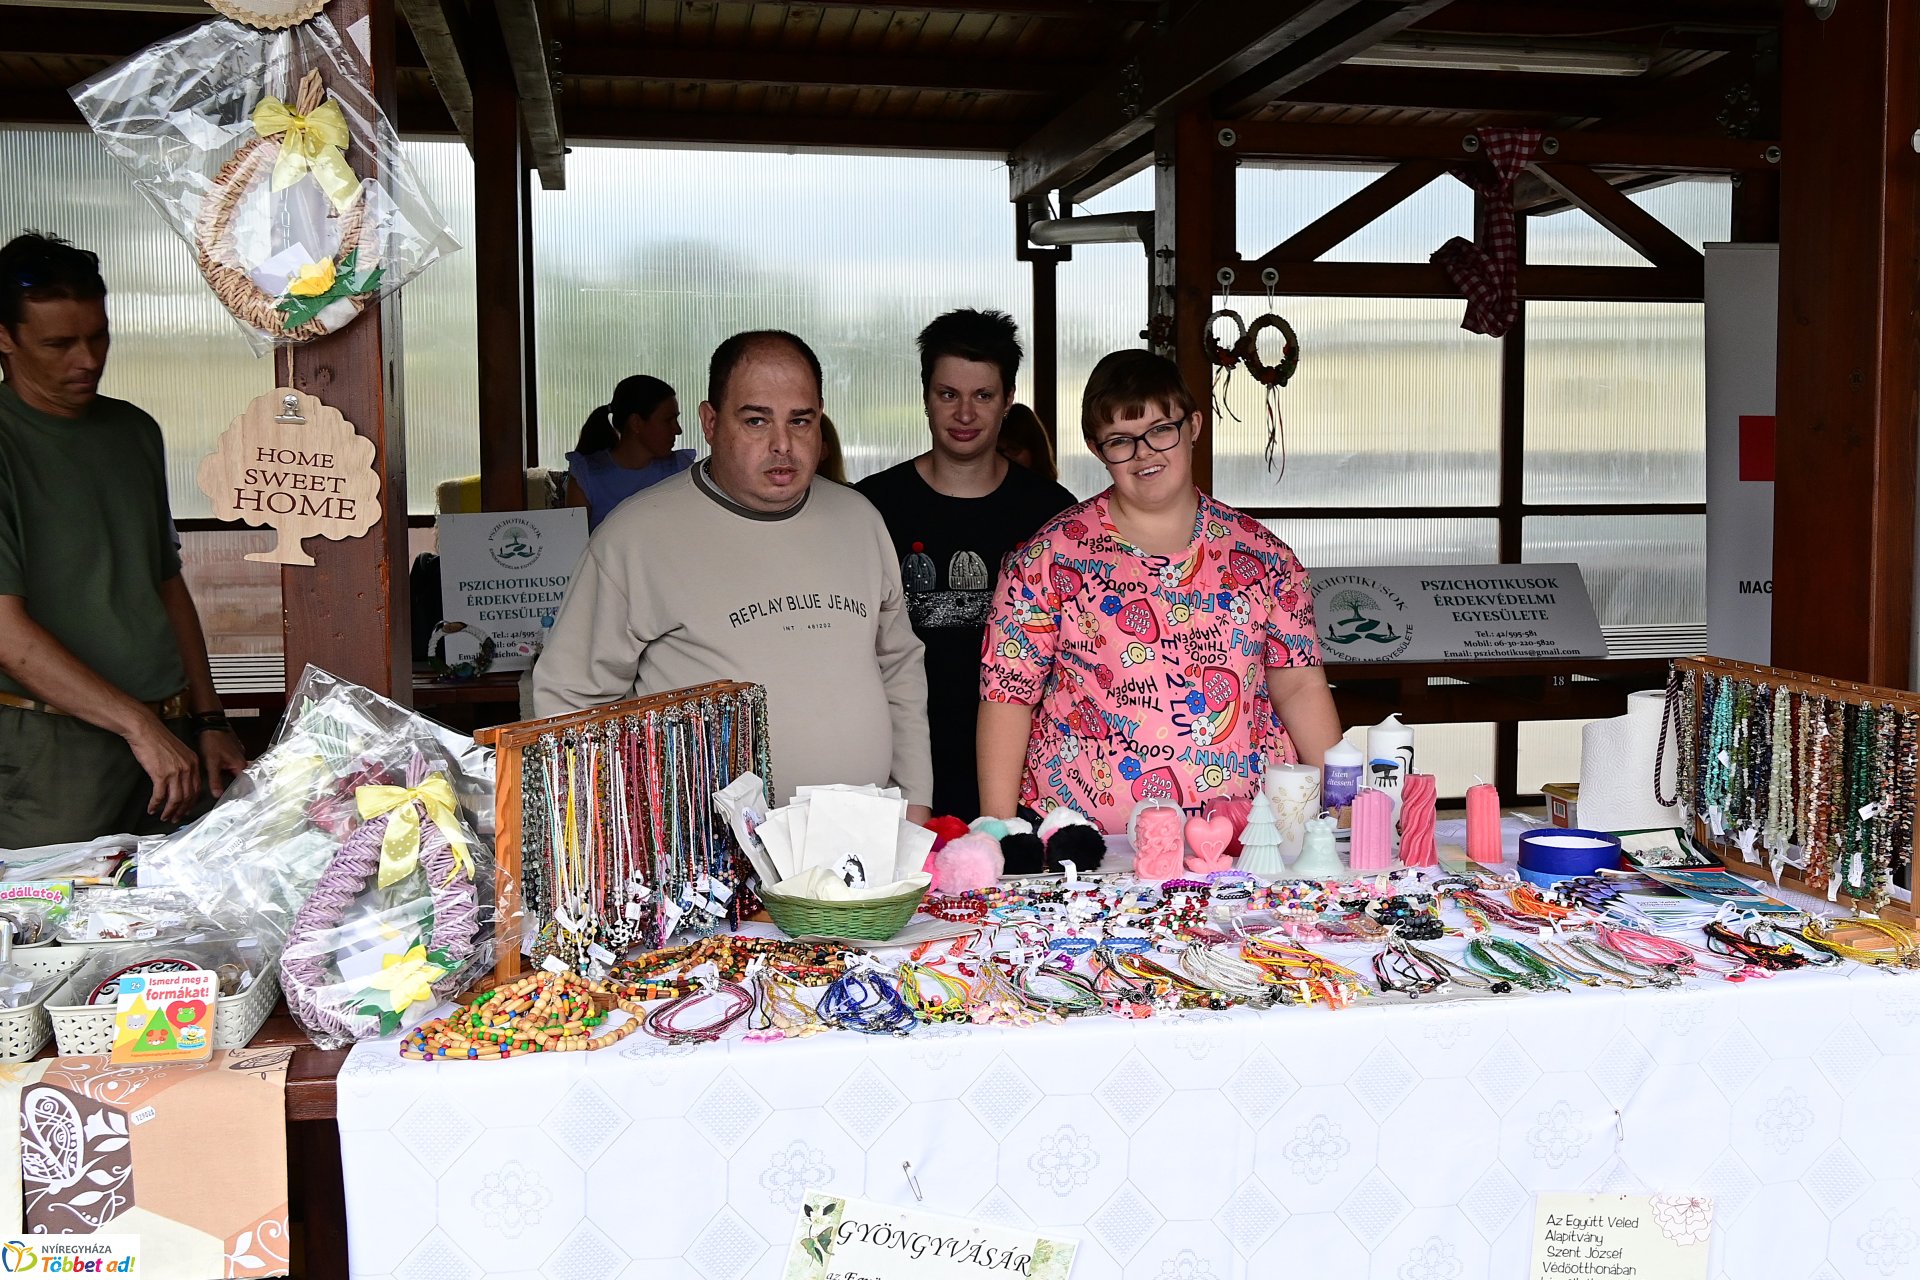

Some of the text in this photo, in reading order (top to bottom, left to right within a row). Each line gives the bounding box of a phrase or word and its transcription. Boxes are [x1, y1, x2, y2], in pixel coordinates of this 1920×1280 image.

[256, 447, 334, 469] HOME
[244, 468, 346, 493] SWEET
[233, 487, 357, 521] HOME
[459, 576, 570, 592] PSZICHOTIKUSO
[1421, 578, 1559, 591] PSZICHOTIKUSOK
[467, 591, 564, 607] ÉRDEKVÉDELM
[1434, 594, 1556, 607] ÉRDEKVÉDELMI
[729, 594, 867, 629] REPLAY BLUE JEANS
[1452, 609, 1549, 622] EGYESÜLETE
[510, 630, 540, 640] 42/595-
[1173, 624, 1222, 643] HAPPEN
[1475, 630, 1538, 639] Tel.: 42/595-581
[1184, 641, 1228, 654] THINGS
[1464, 640, 1493, 648] Mobil:
[1190, 650, 1228, 666] GOOD
[1443, 648, 1581, 658] Email: pszichotikus@gmail.com
[1106, 675, 1158, 700] HAPPEN
[1205, 673, 1223, 689] GUYS
[1208, 679, 1230, 699] BEFORE
[999, 680, 1033, 700] GOOD
[1215, 687, 1233, 704] FRIES
[1115, 695, 1164, 712] THINGS
[1177, 746, 1249, 778] FUNNY
[1332, 770, 1349, 778] Isten
[1067, 767, 1099, 808] THINGS
[131, 982, 141, 990] 2+
[149, 976, 180, 986] Ismerd
[182, 977, 201, 985] meg
[146, 986, 209, 1001] formákat!
[1546, 1214, 1563, 1226] Az
[1607, 1216, 1639, 1229] Veled
[1545, 1229, 1604, 1246] Alapítvány
[836, 1220, 1032, 1277] GYÖNGYVÁSÁR
[1547, 1246, 1623, 1259] Szent József
